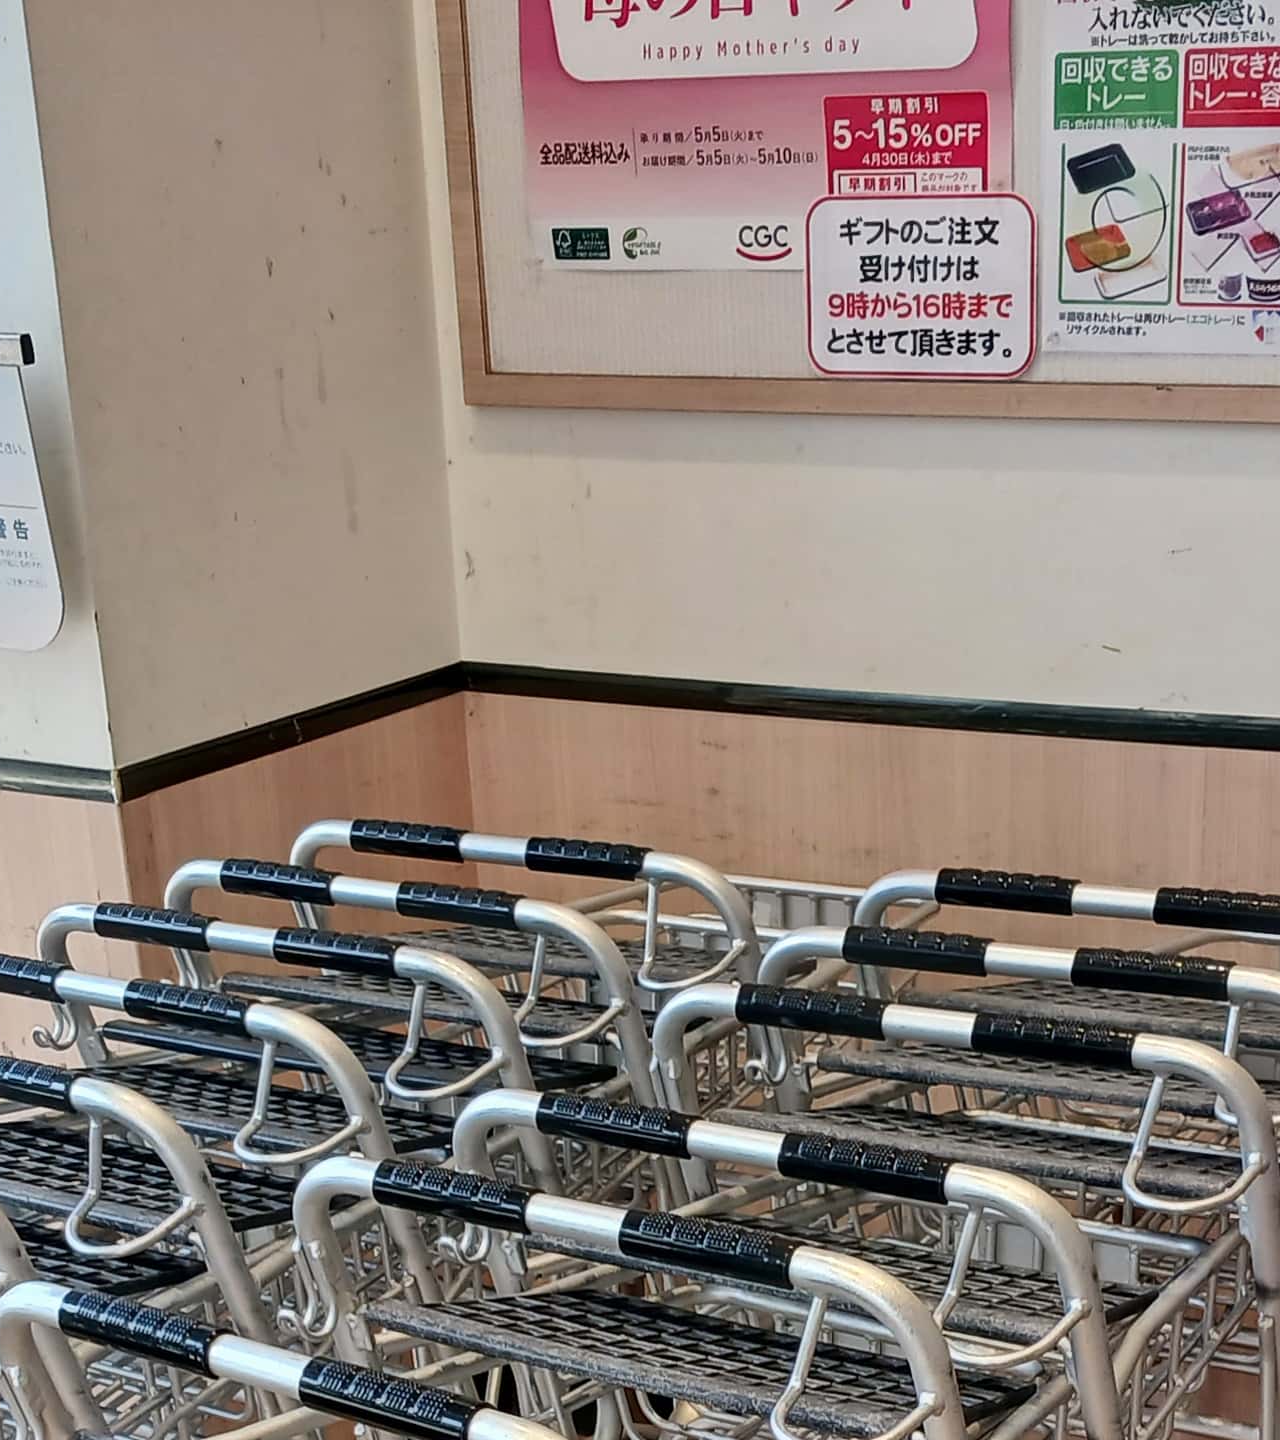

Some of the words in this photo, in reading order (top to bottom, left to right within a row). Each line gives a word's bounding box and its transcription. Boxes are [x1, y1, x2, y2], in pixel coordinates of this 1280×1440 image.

[1088, 3, 1275, 32] 入れないでください。
[643, 43, 703, 61] Happy
[717, 37, 810, 58] Mother's
[824, 35, 862, 55] day
[1061, 55, 1173, 85] 回収できる
[870, 97, 939, 115] 早期割引
[1086, 85, 1147, 112] トレー
[540, 142, 631, 166] 全品配送料込み
[848, 177, 907, 193] 早期割引
[738, 225, 789, 248] CGC
[839, 216, 999, 246] ギフトのご注文
[859, 254, 979, 283] 受け付けは
[828, 292, 1013, 320] 9時から16時まで
[827, 329, 1012, 358] とさせて頂きます。
